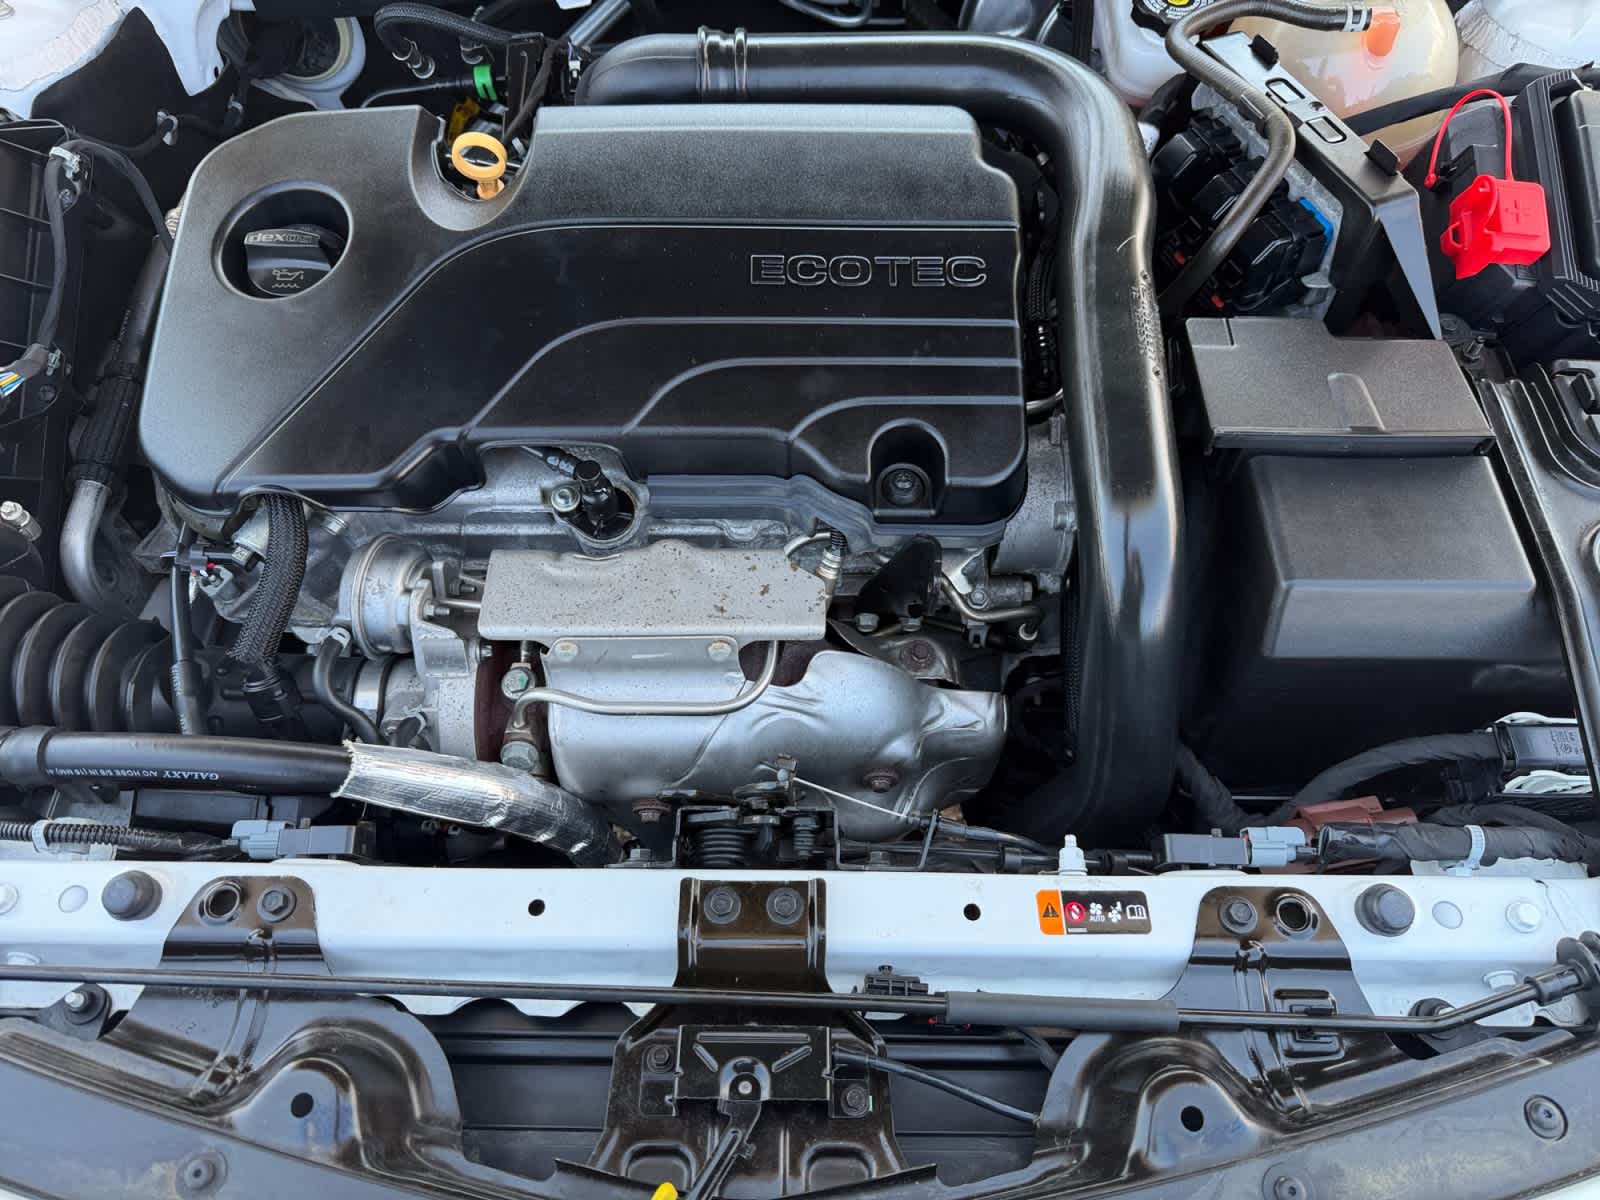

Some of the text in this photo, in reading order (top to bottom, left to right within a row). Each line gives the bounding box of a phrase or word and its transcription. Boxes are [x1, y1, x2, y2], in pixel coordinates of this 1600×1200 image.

[750, 254, 987, 287] ECOTEC
[113, 769, 141, 777] HOSE
[163, 770, 219, 781] GALAXY
